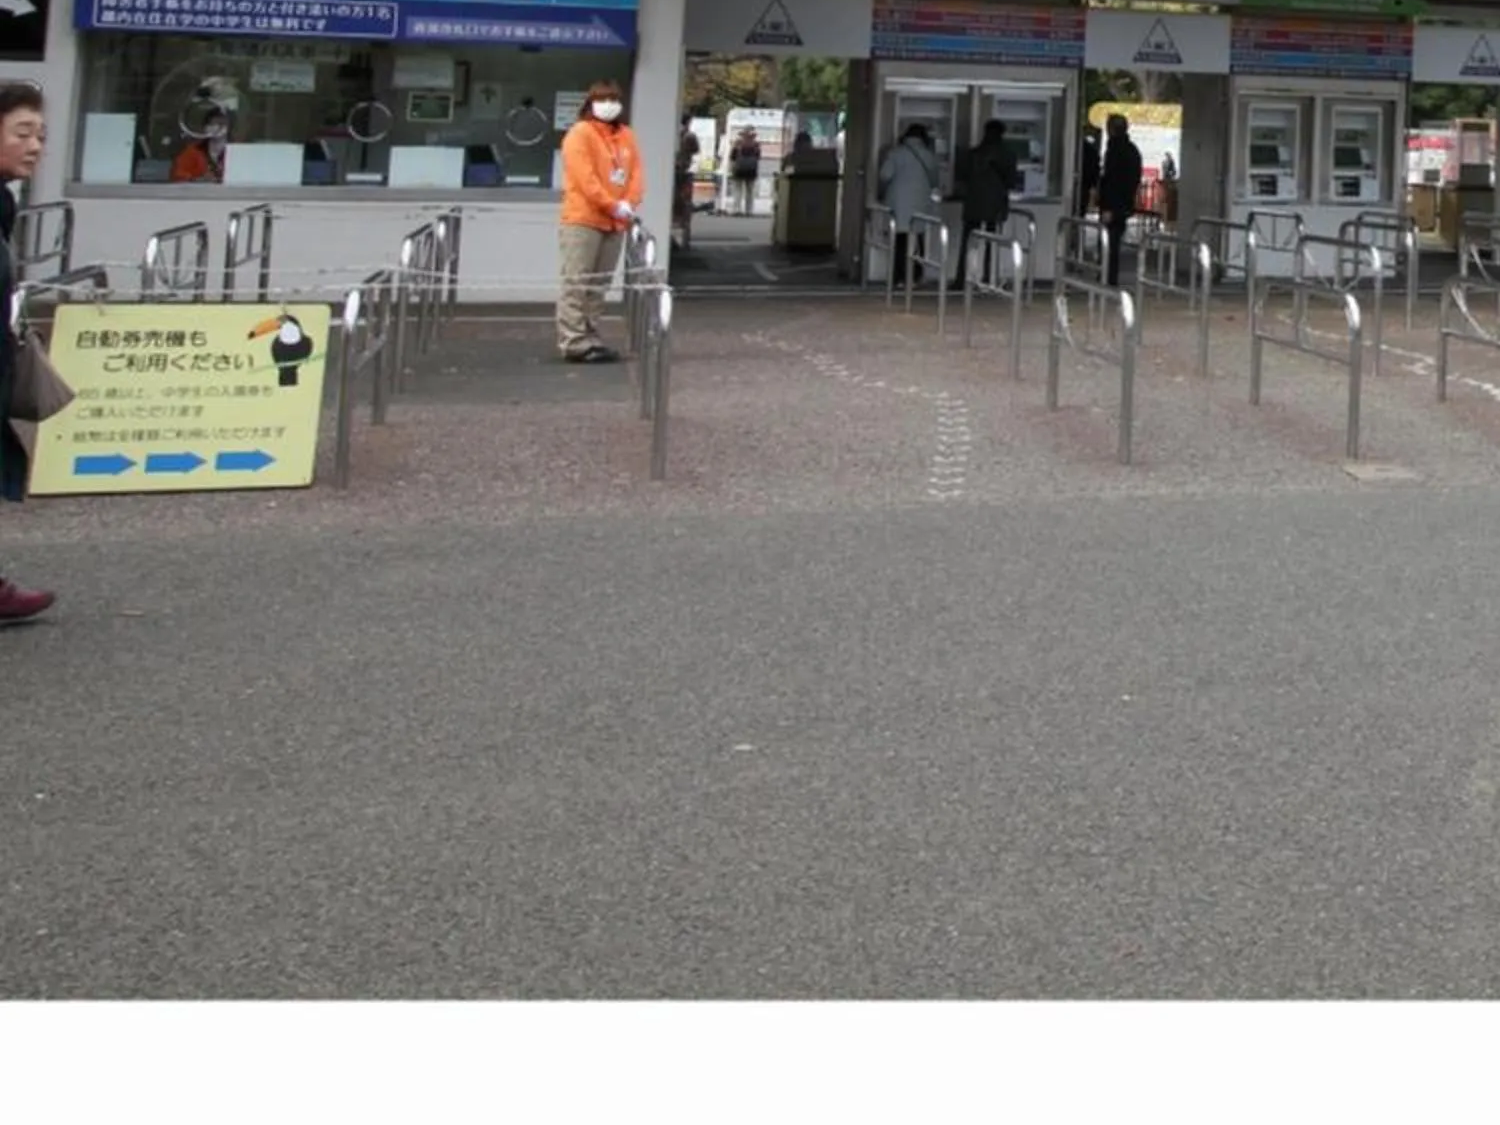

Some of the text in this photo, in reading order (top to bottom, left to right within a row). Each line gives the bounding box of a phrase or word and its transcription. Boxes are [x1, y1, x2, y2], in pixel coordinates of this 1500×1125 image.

[75, 330, 208, 350] 自動券売機も
[102, 353, 255, 374] ご利用ください
[75, 405, 205, 421] ご購入いただけます
